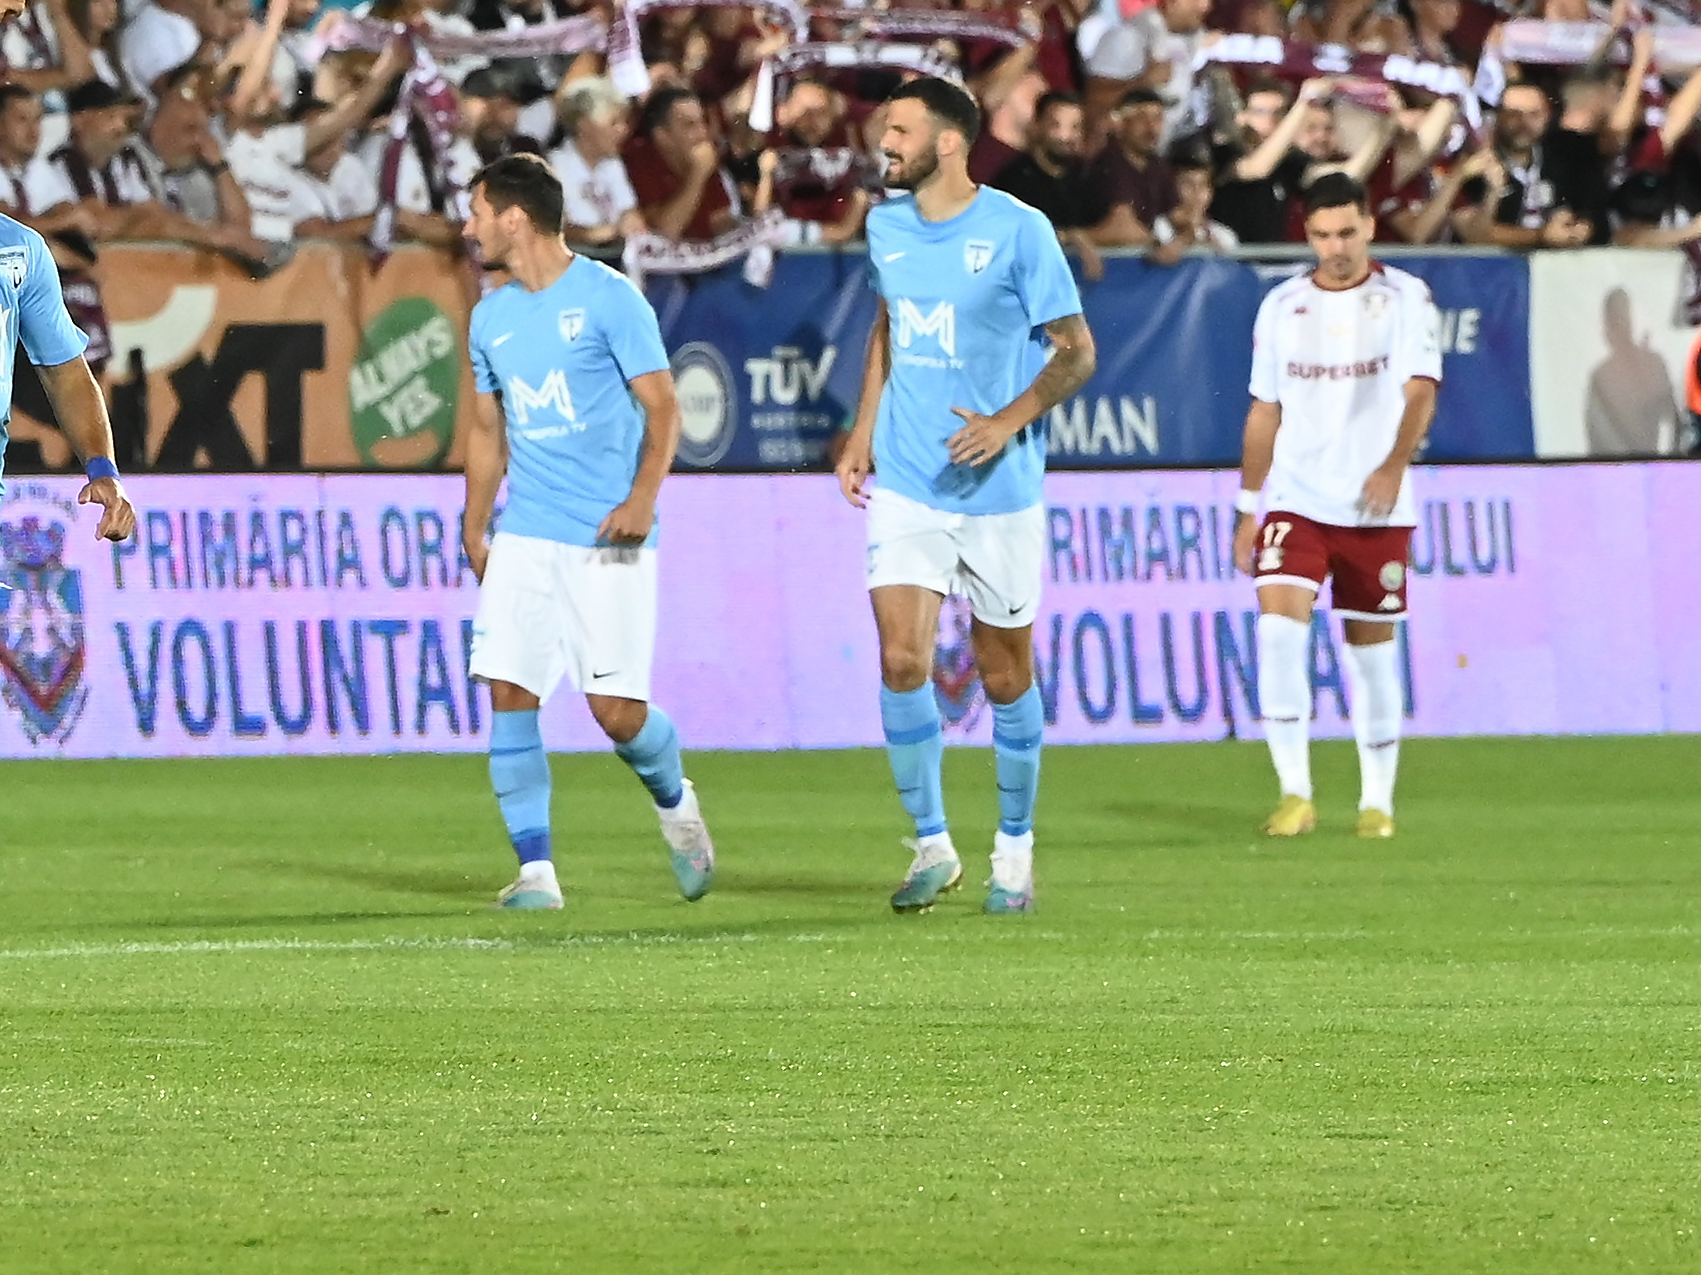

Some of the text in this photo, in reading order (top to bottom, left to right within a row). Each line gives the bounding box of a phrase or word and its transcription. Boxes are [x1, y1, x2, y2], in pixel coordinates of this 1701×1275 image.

[350, 315, 456, 412] ALWAYS
[743, 343, 839, 406] TÜV
[1287, 354, 1389, 380] SUPERBET
[378, 374, 446, 438] YES
[1263, 521, 1293, 547] 17
